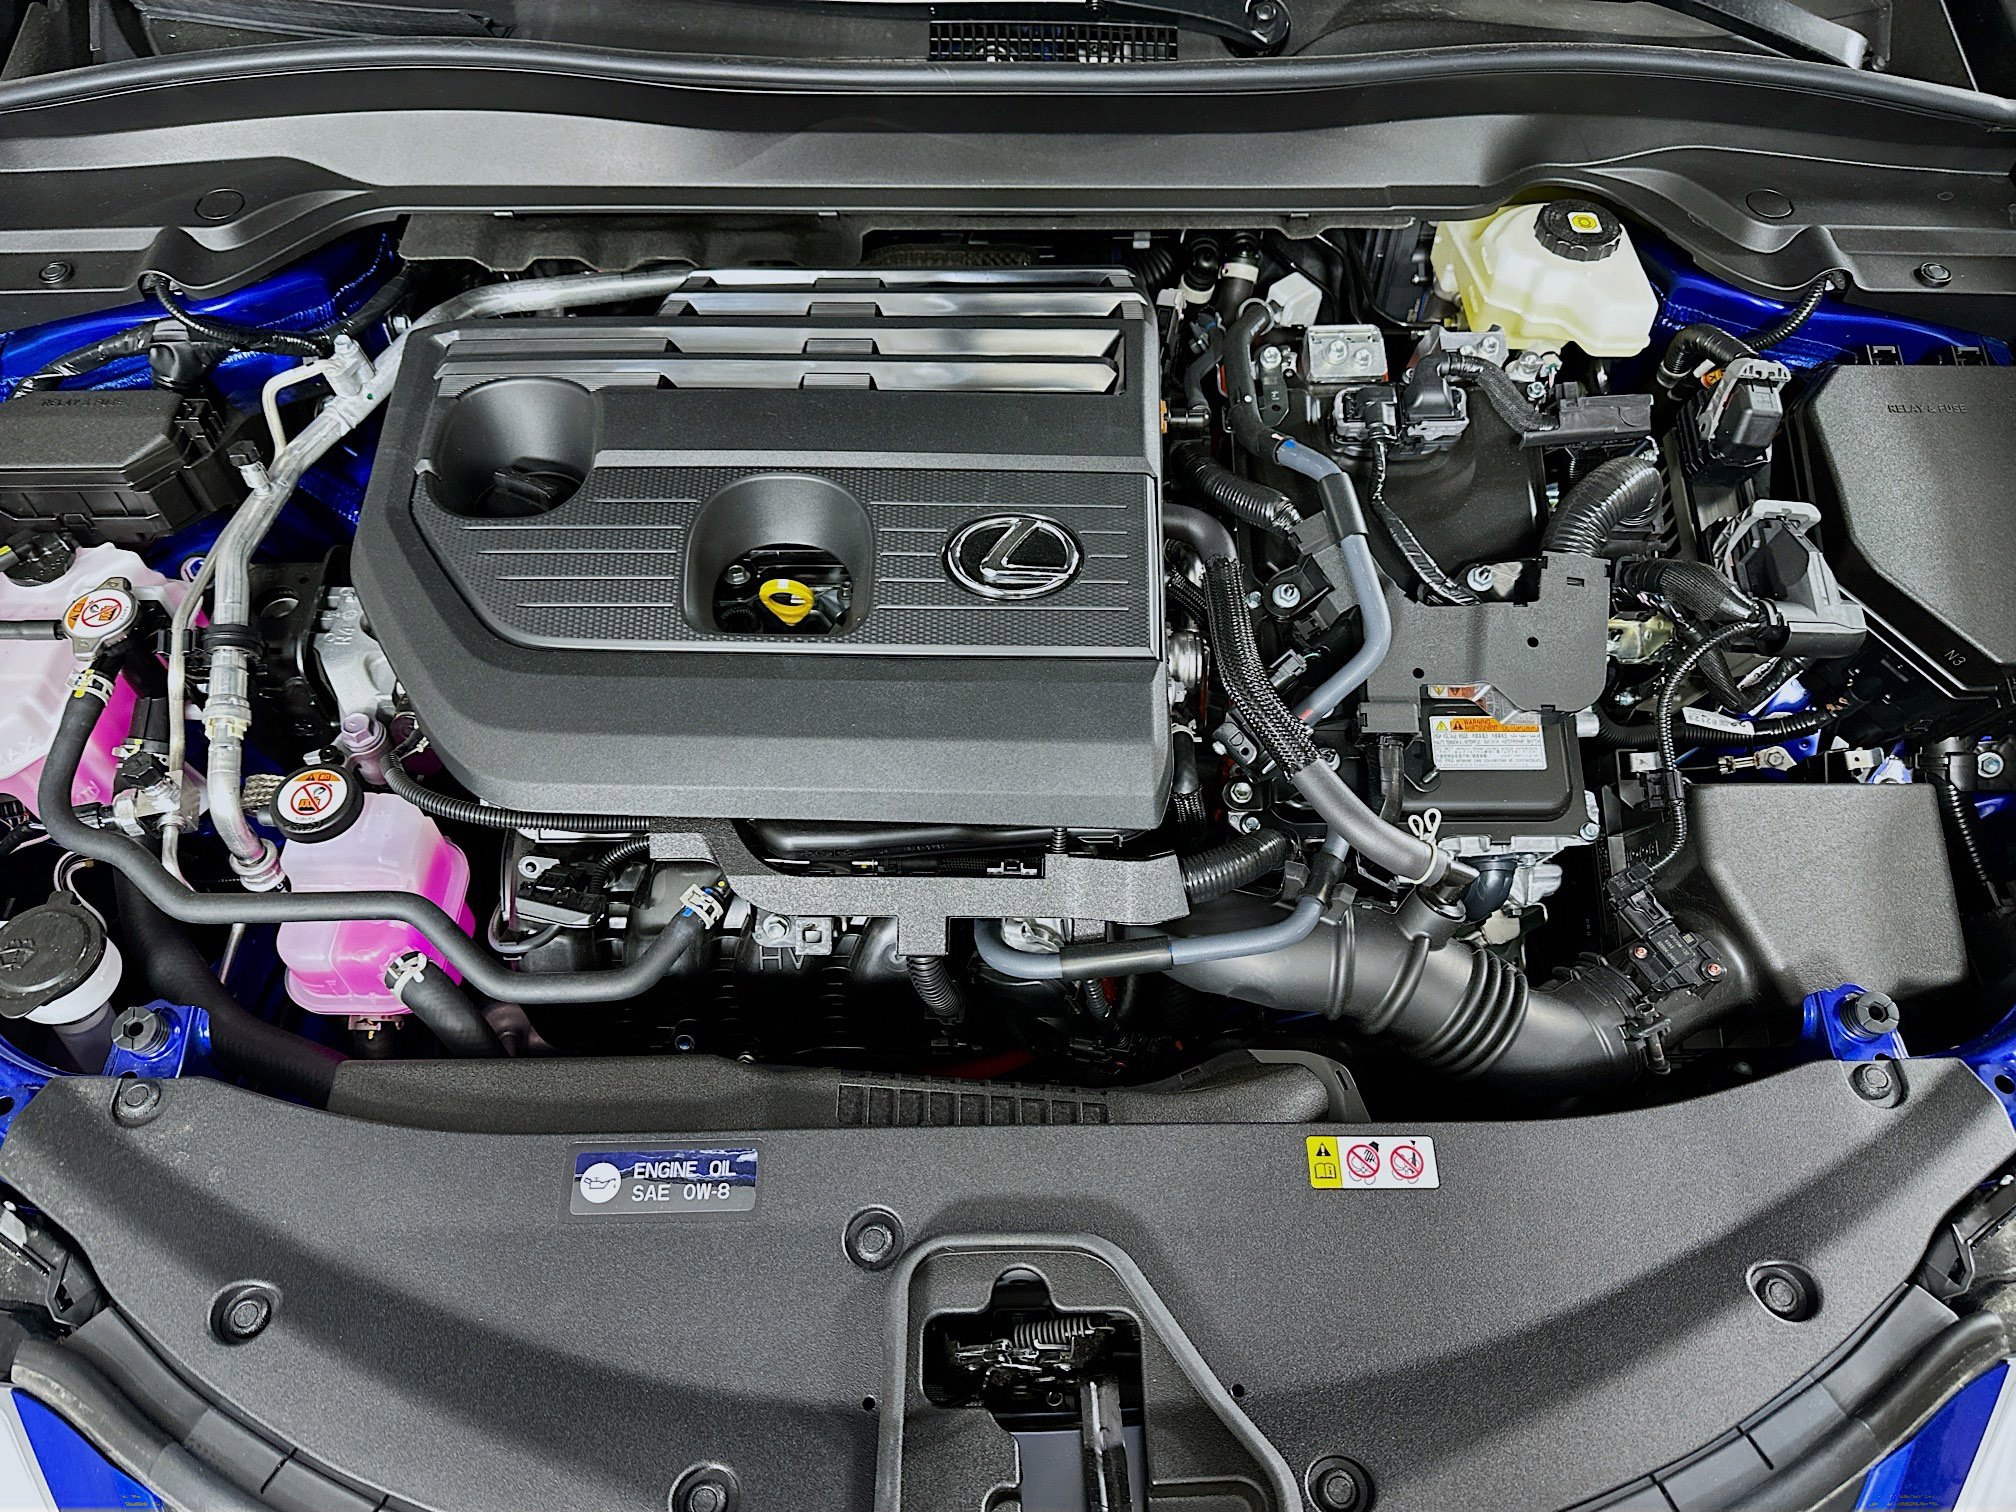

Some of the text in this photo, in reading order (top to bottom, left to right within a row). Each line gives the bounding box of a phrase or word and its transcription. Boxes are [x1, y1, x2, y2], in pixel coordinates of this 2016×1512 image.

[1887, 404, 1968, 413] RELAY & FUSE
[1944, 649, 1967, 666] N3
[632, 1160, 737, 1179] ENGINE OIL
[631, 1182, 730, 1202] SAE 0W-8
